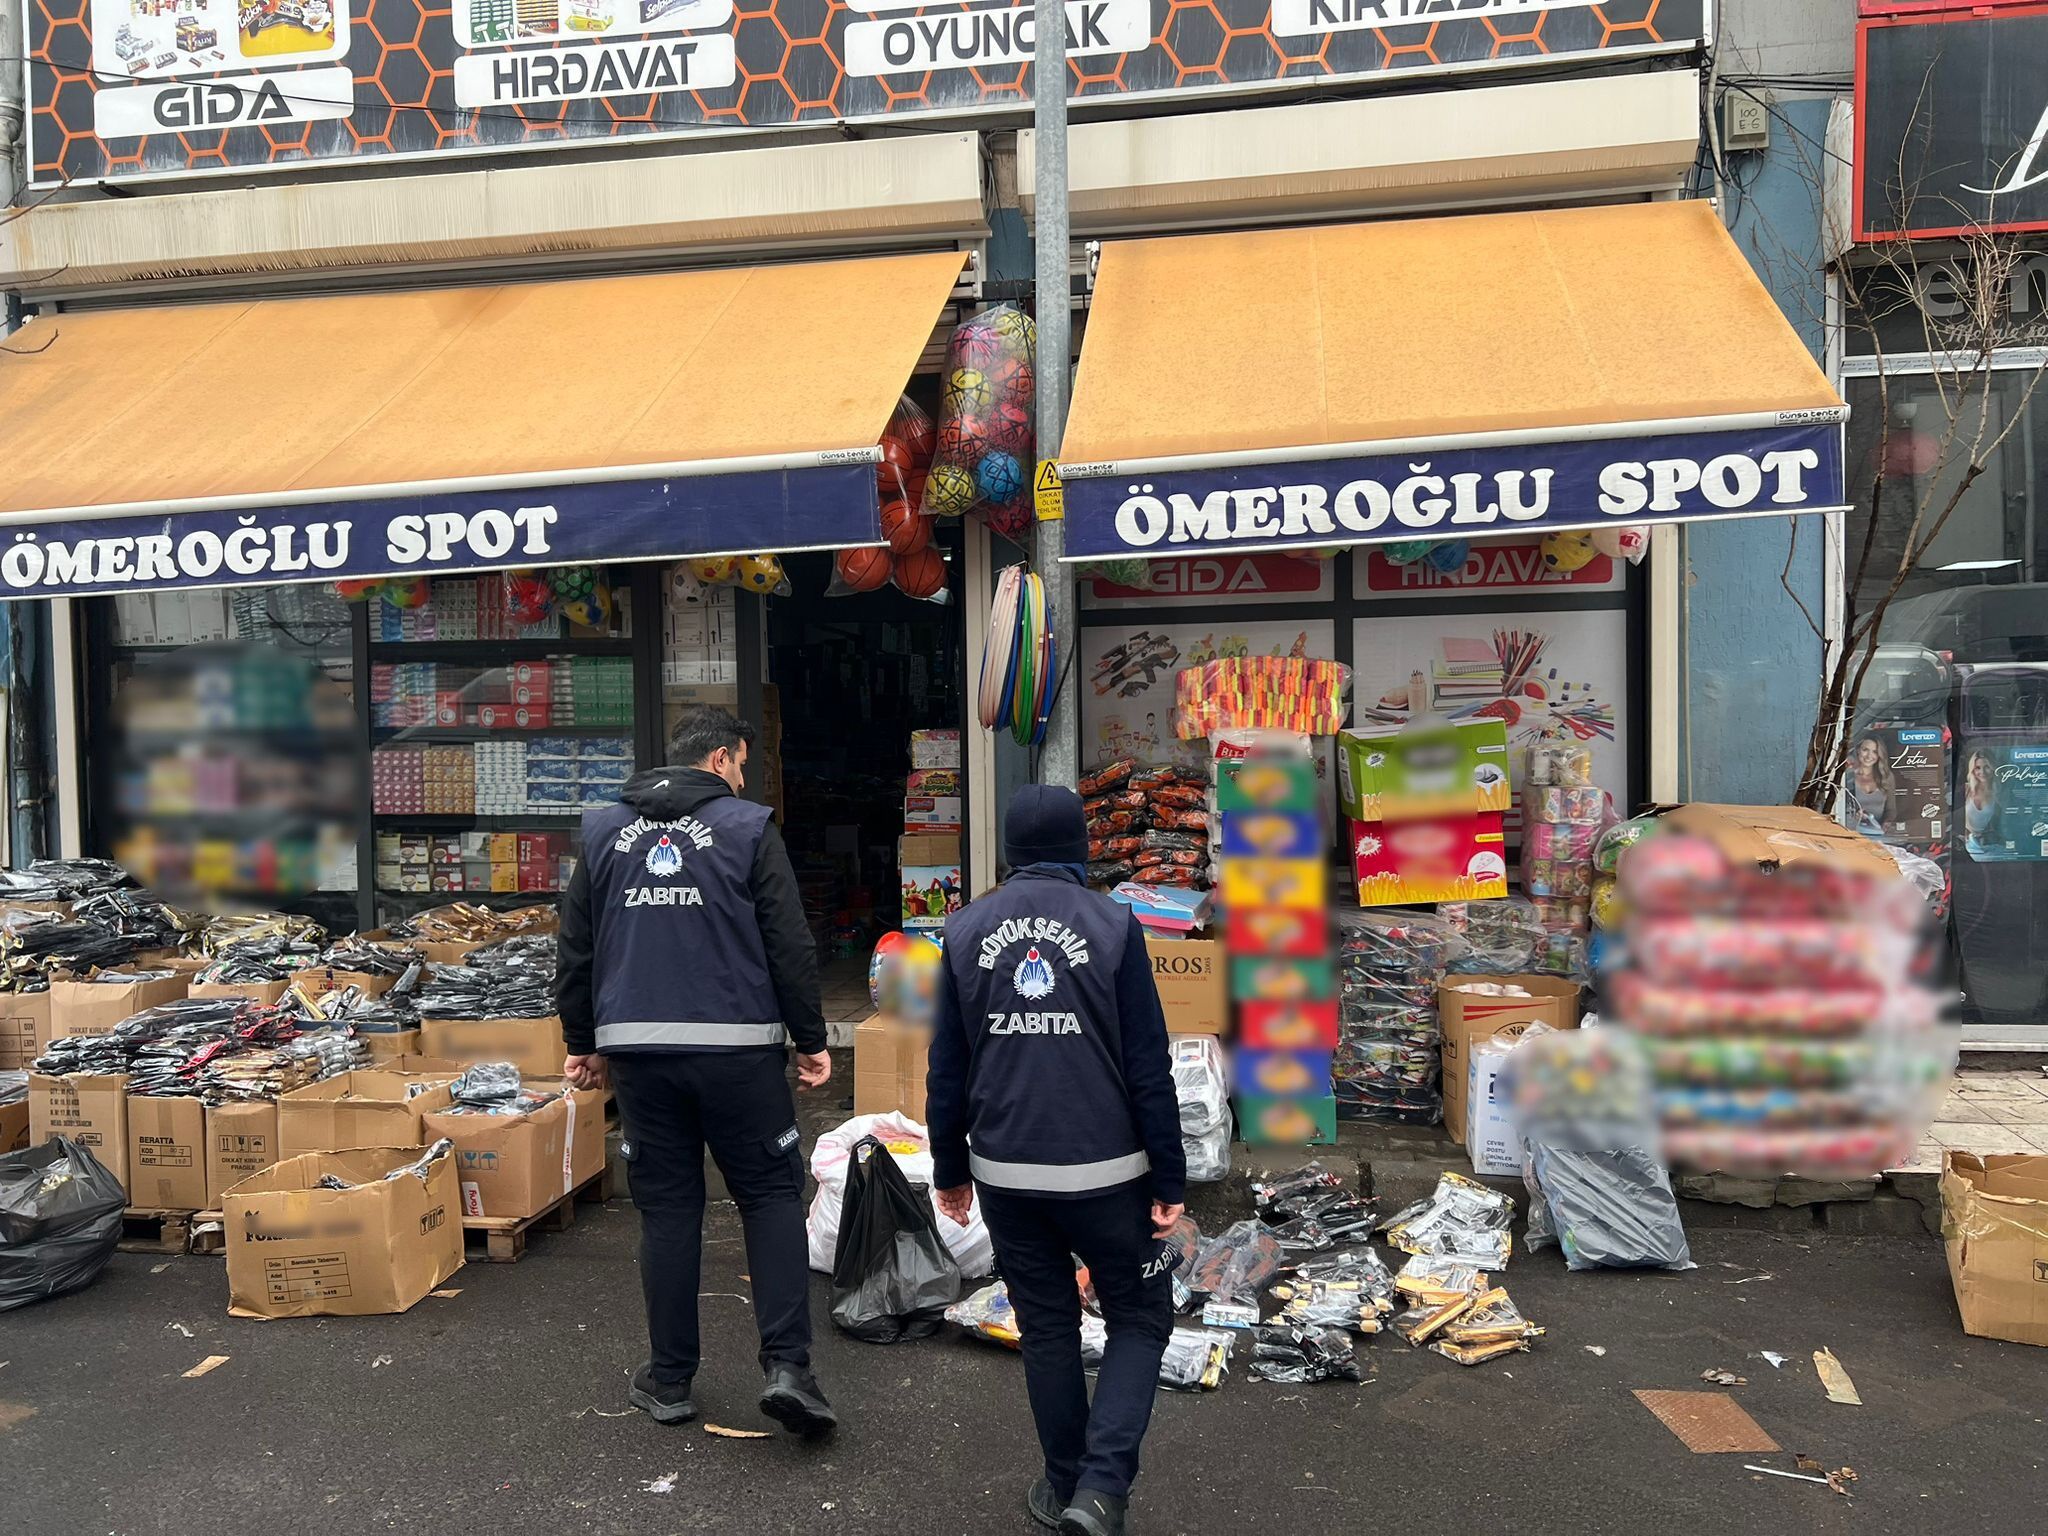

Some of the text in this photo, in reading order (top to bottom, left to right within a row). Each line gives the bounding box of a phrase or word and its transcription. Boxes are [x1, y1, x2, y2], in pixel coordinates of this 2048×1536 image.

[493, 43, 698, 100] HIRDAVAT
[153, 79, 293, 128] GIDA
[1114, 449, 1818, 547] ÖMEROĞLU SPOT
[1, 505, 558, 587] ÖMEROĞLU SPOT
[1150, 558, 1268, 593] GIDA
[1902, 733, 1936, 741] Lorenzo
[1890, 745, 1928, 769] Lotus
[624, 887, 704, 908] ZABITA
[978, 917, 1090, 970] BÜYÜKŞEHİR
[1149, 956, 1203, 975] ROS
[988, 1013, 1082, 1035] ZABITA
[139, 1136, 174, 1145] BERATTA
